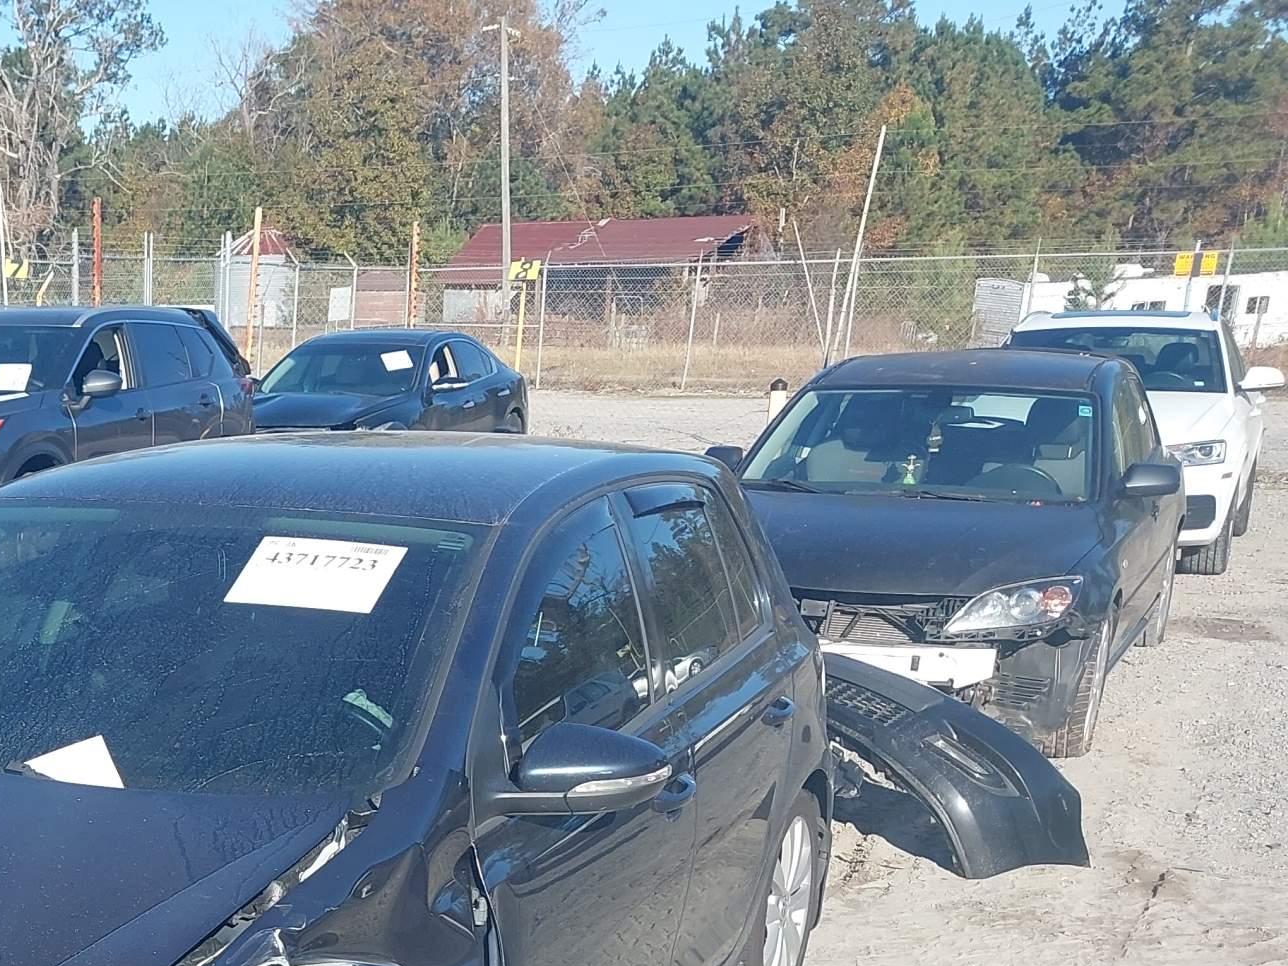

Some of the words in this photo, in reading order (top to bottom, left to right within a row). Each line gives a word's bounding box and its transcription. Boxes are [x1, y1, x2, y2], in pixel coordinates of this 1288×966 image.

[10, 259, 23, 278] 7
[515, 262, 532, 279] 8
[265, 551, 379, 571] 43717723
